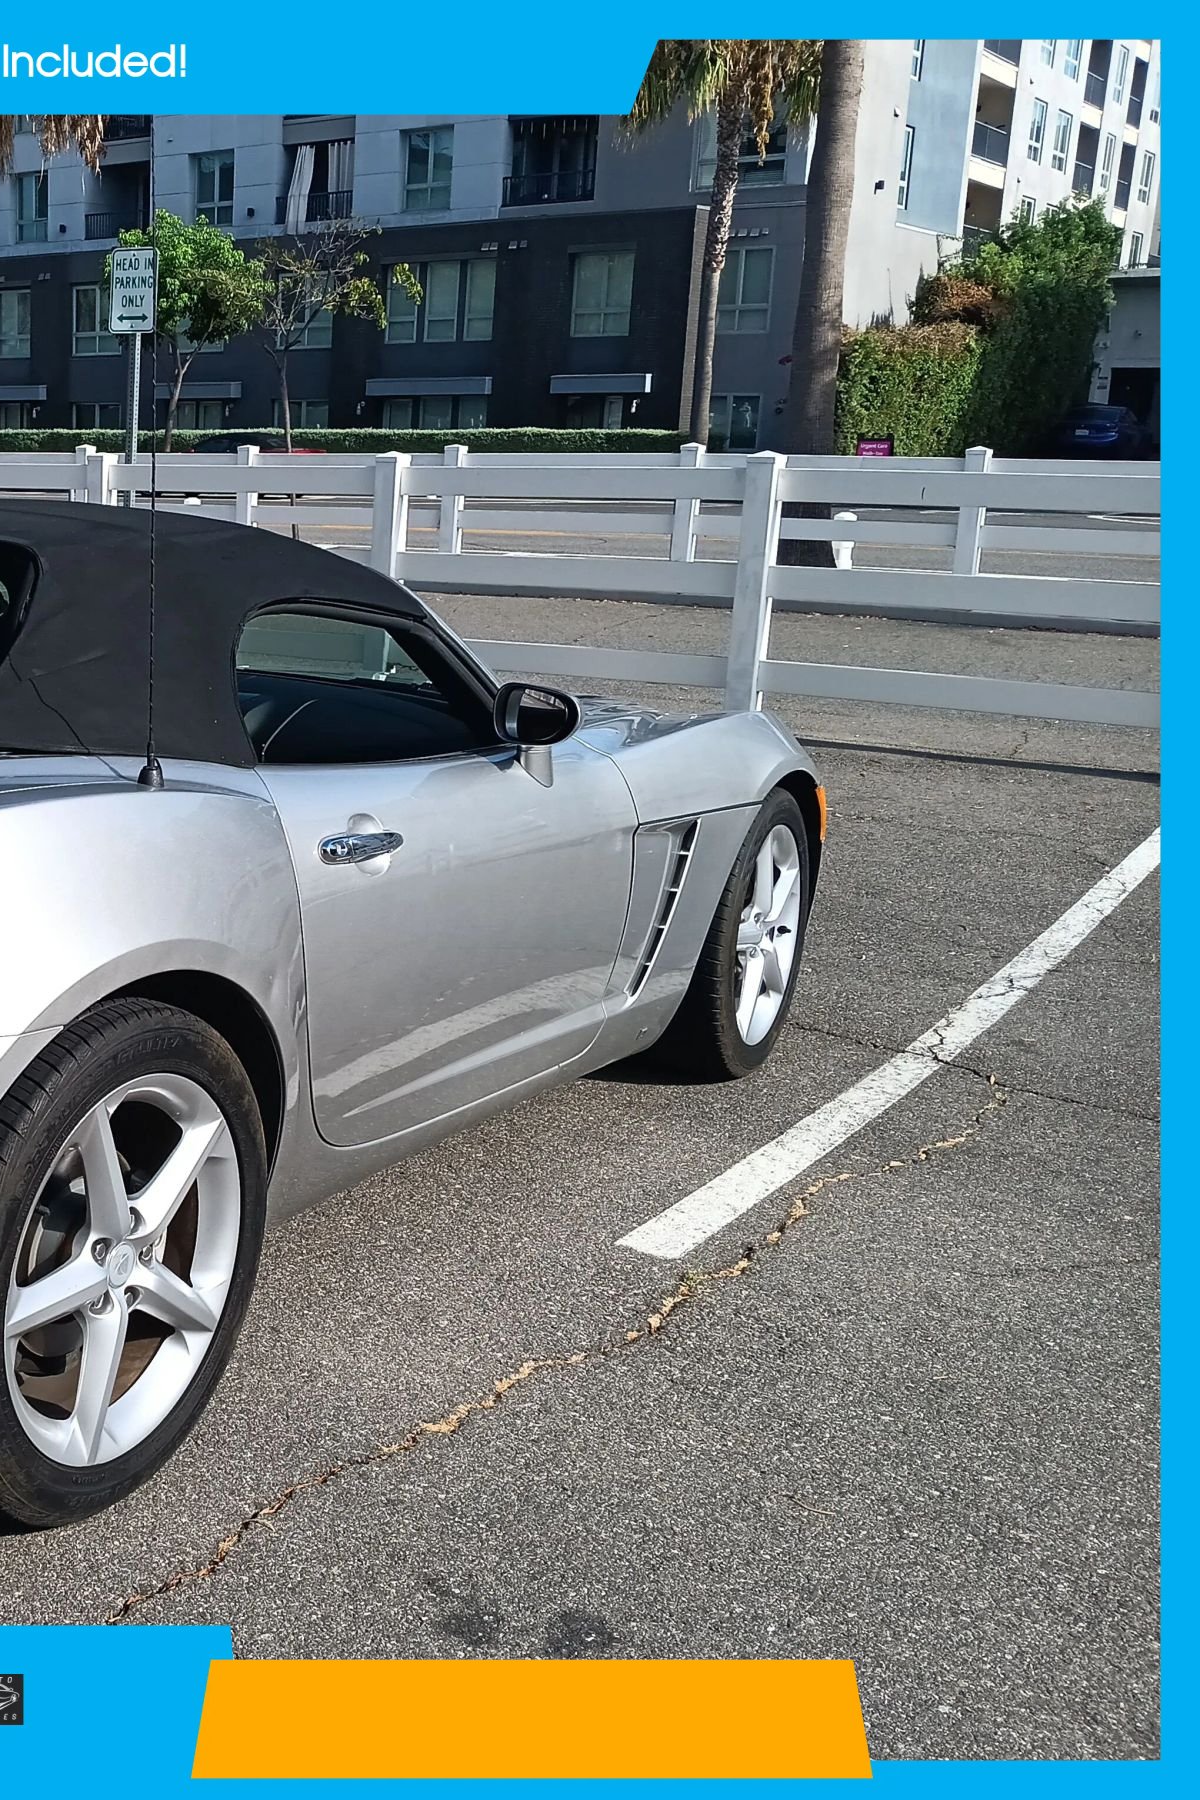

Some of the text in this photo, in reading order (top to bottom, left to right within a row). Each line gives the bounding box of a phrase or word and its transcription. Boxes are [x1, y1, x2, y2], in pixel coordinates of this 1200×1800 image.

[116, 258, 140, 271] HEAD
[115, 276, 153, 289] PARKING
[121, 295, 145, 308] ONLY
